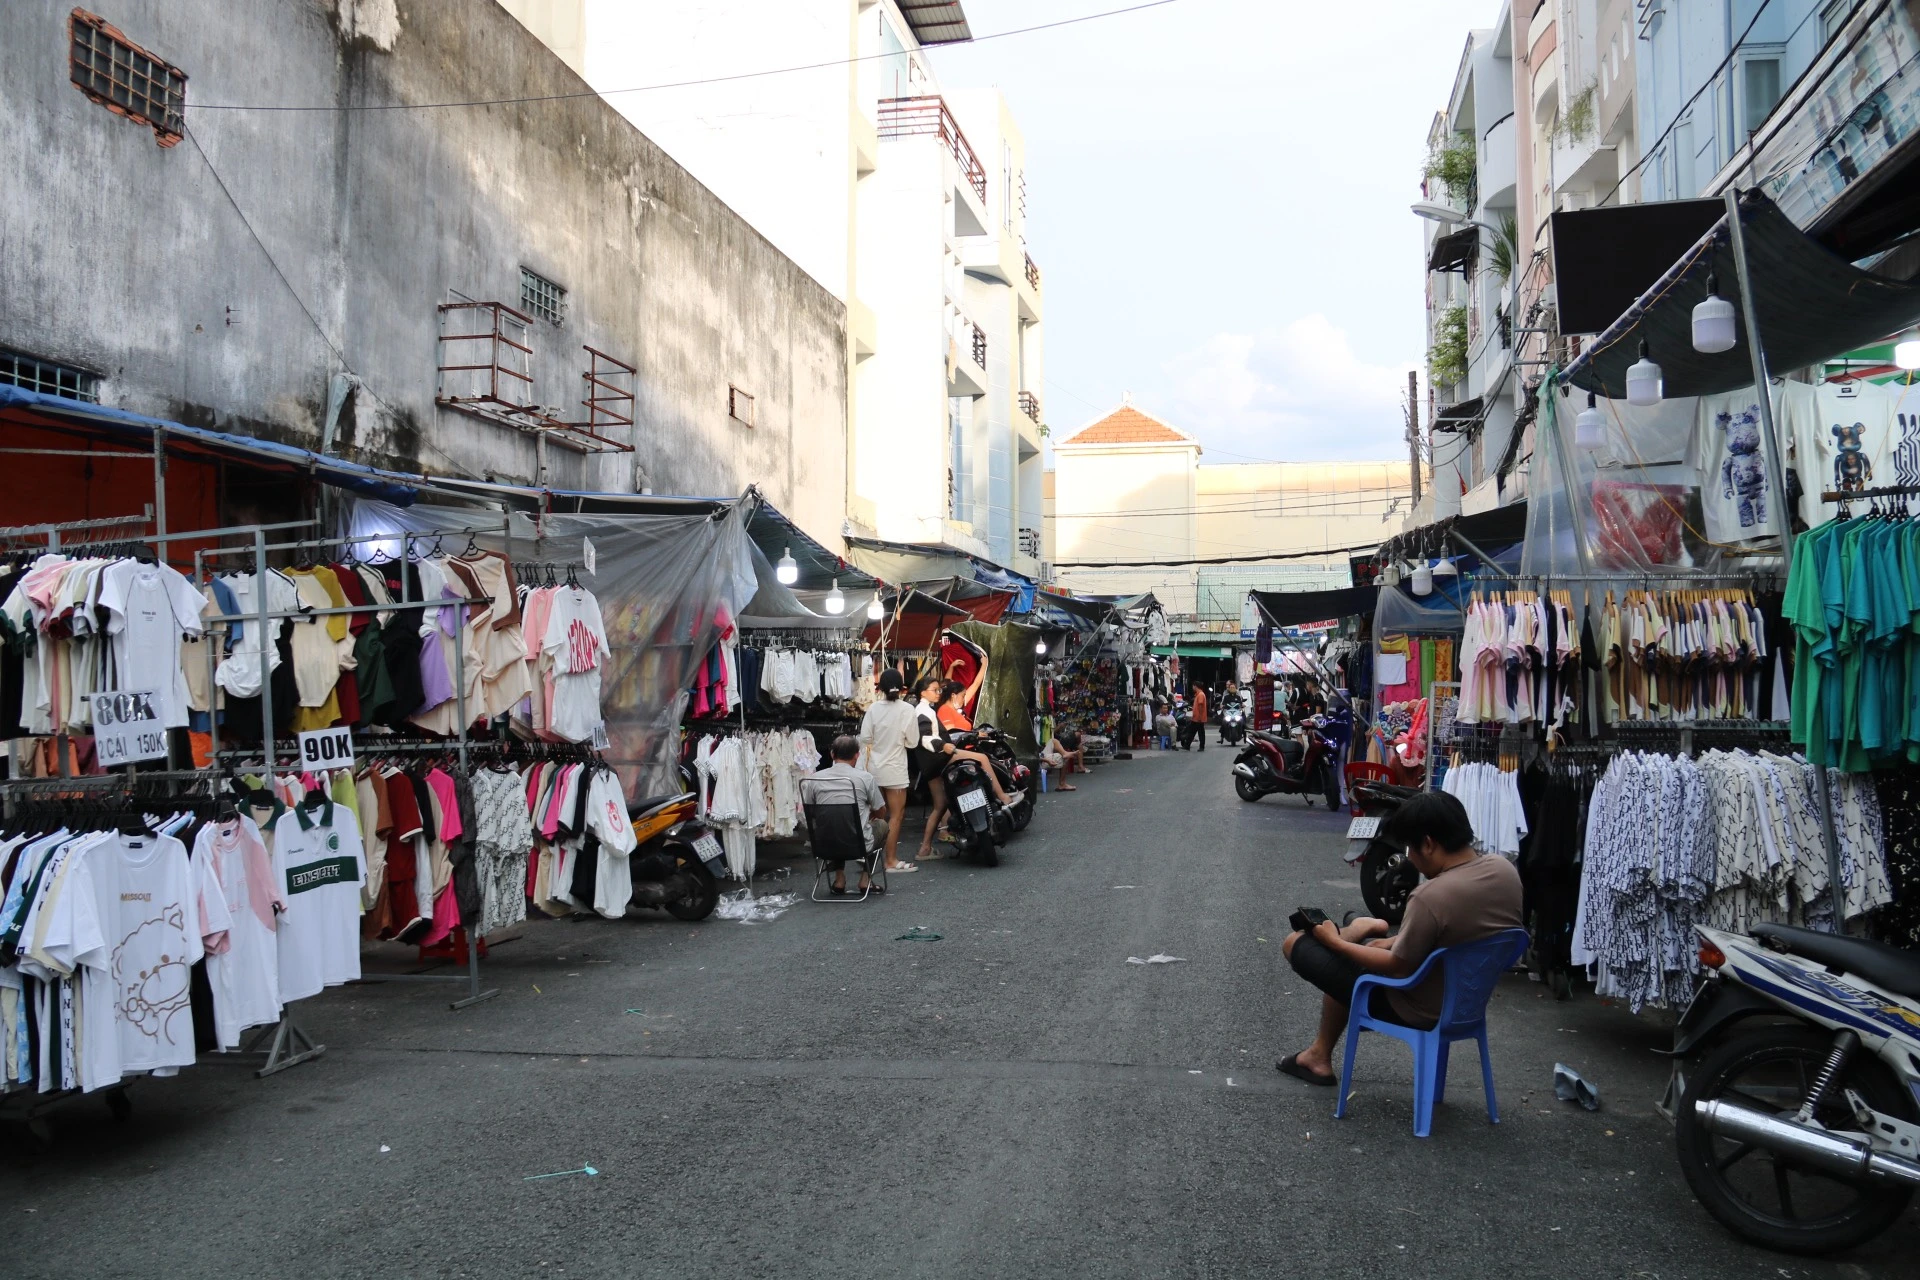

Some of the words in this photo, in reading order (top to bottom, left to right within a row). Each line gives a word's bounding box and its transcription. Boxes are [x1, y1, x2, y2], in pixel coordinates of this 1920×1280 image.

[96, 692, 158, 726] 80K
[98, 740, 105, 759] 2
[137, 732, 165, 754] 150K
[304, 734, 351, 762] 90K
